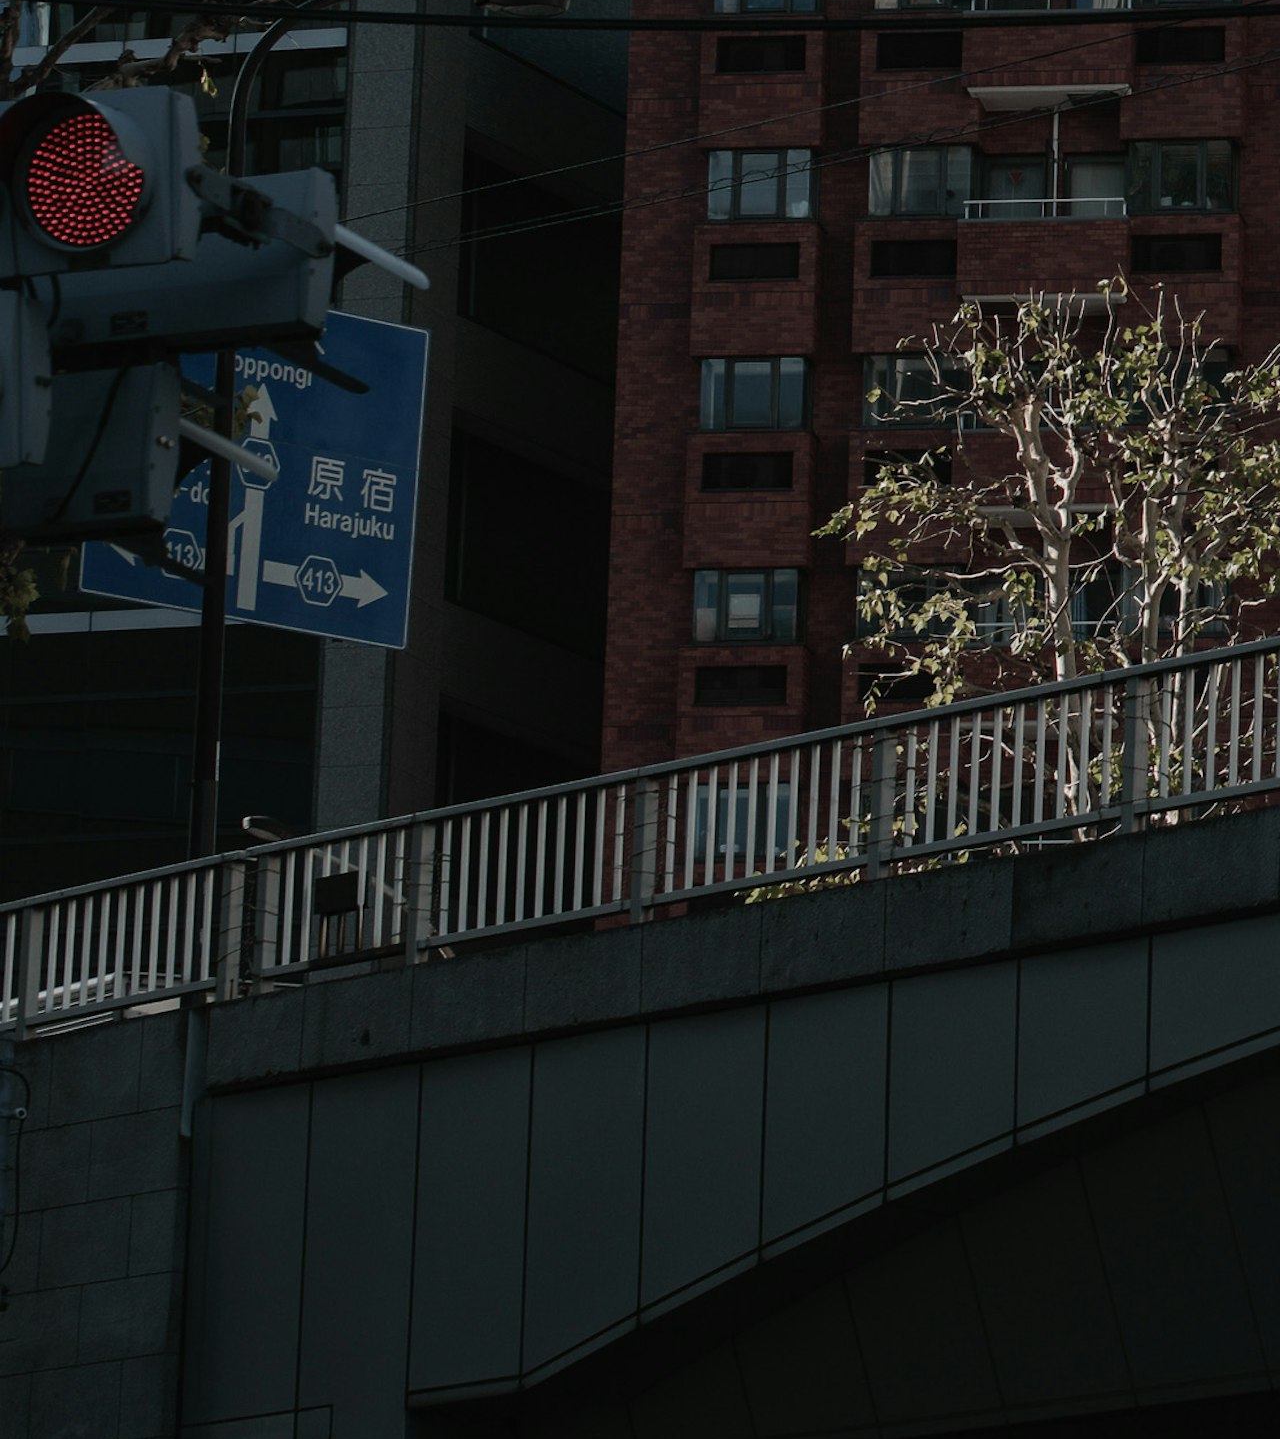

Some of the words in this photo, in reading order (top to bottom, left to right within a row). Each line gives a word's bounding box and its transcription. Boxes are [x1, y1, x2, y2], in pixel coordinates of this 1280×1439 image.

[234, 354, 313, 390] oppongi
[307, 455, 398, 514] 原宿
[304, 502, 395, 541] Harajuku
[302, 567, 335, 595] 413
